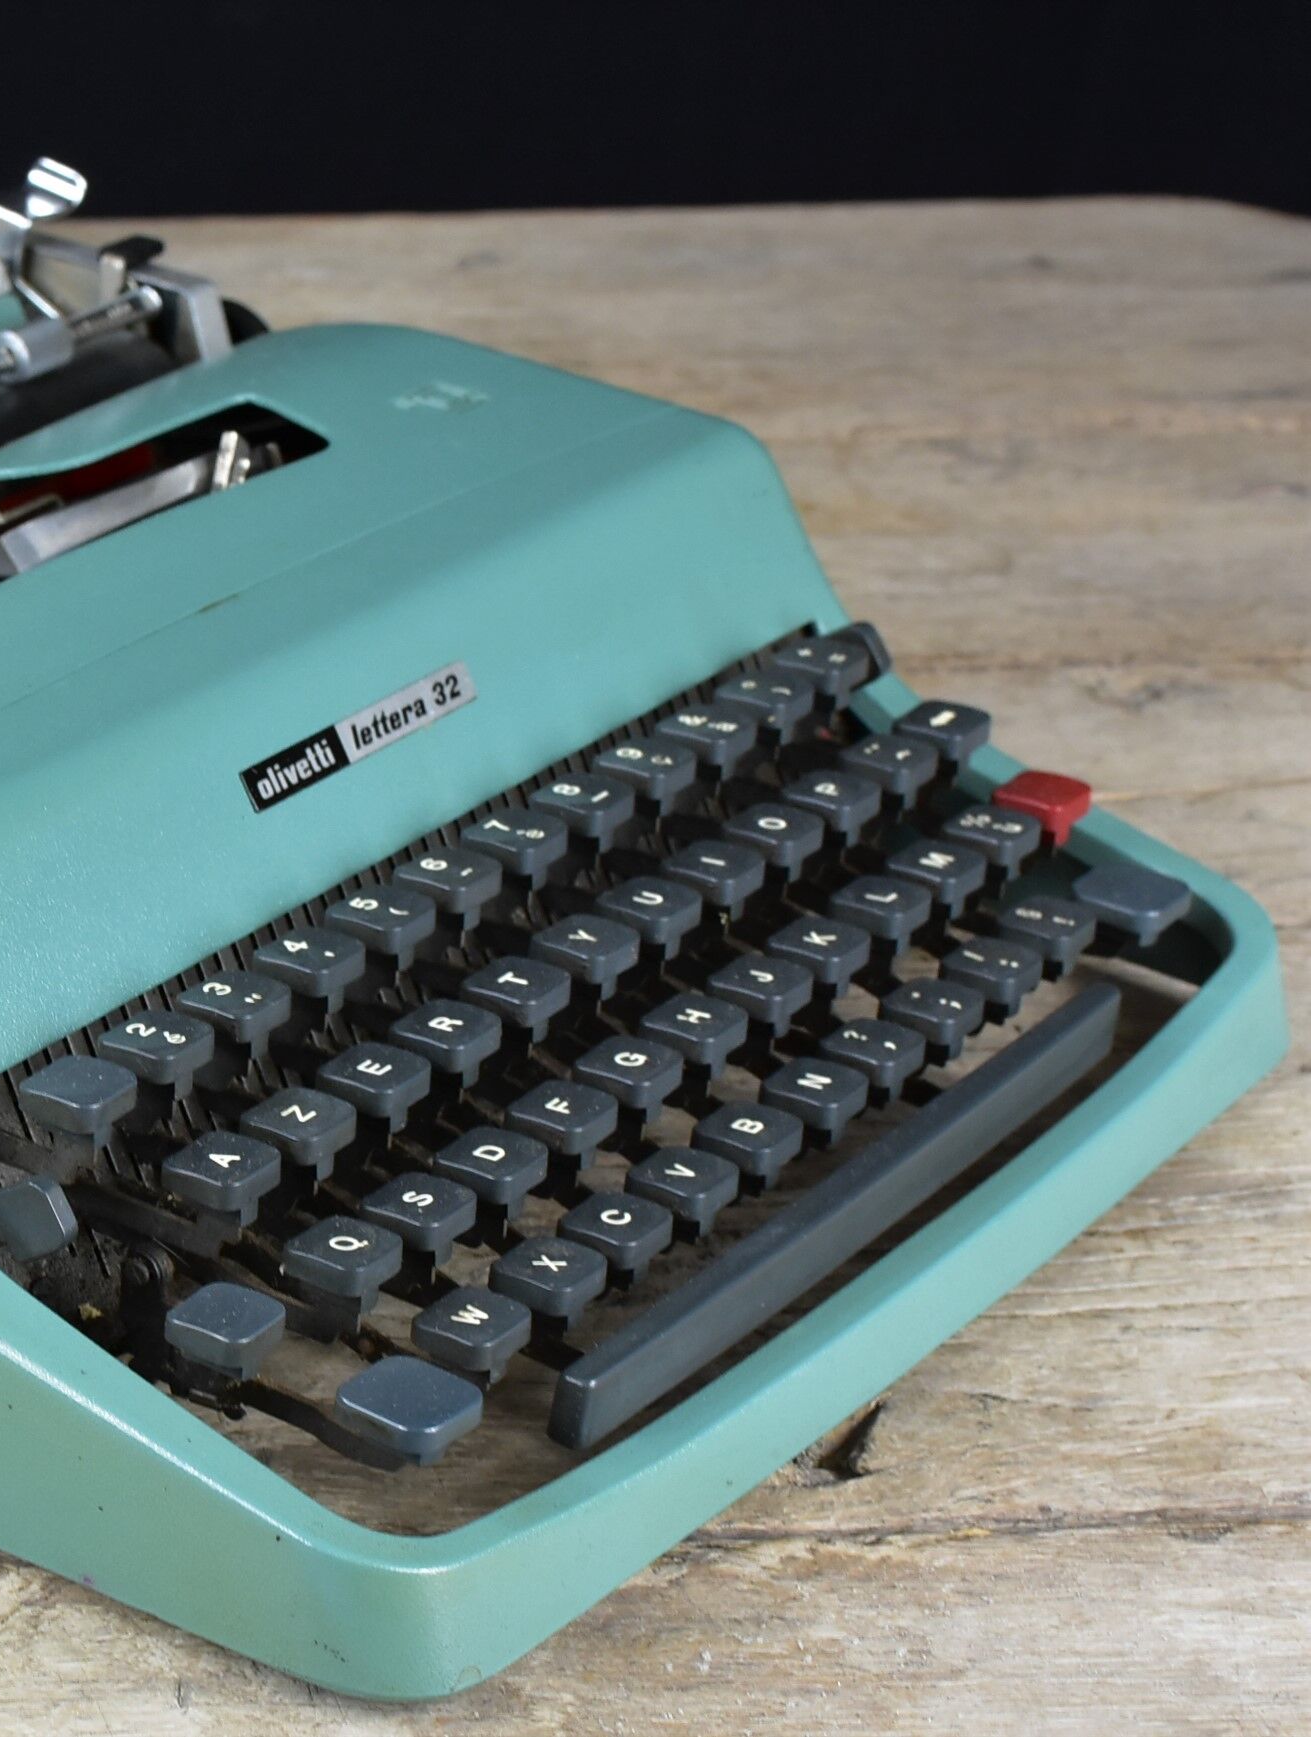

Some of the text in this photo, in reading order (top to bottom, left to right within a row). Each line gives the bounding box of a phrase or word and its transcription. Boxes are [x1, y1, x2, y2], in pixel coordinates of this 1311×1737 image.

[256, 674, 462, 801] olivetti lettera 32
[552, 783, 581, 796] 8
[814, 783, 838, 796] P
[484, 819, 510, 832] 7
[758, 817, 787, 830] O
[419, 858, 448, 871] 6
[700, 856, 726, 867] I
[919, 852, 954, 869] M
[349, 897, 379, 911] 5
[633, 891, 664, 905] U
[865, 892, 898, 903] L
[569, 929, 596, 942] Y
[803, 931, 837, 946] K
[283, 940, 309, 953] 4
[497, 971, 529, 986] T
[750, 970, 774, 983] J
[202, 982, 232, 996] 3
[428, 1016, 464, 1032] R
[676, 1008, 712, 1024] H
[125, 1022, 157, 1038] 2
[614, 1051, 648, 1067] G
[356, 1059, 393, 1076] E
[797, 1073, 832, 1090] N
[280, 1104, 317, 1123] Z
[544, 1097, 571, 1115] F
[730, 1118, 764, 1135] B
[208, 1153, 241, 1169] A
[472, 1144, 506, 1162] D
[665, 1163, 696, 1178] V
[402, 1190, 434, 1207] S
[600, 1209, 632, 1226] C
[328, 1235, 369, 1251] Q
[532, 1254, 568, 1272] X
[450, 1304, 489, 1325] W
